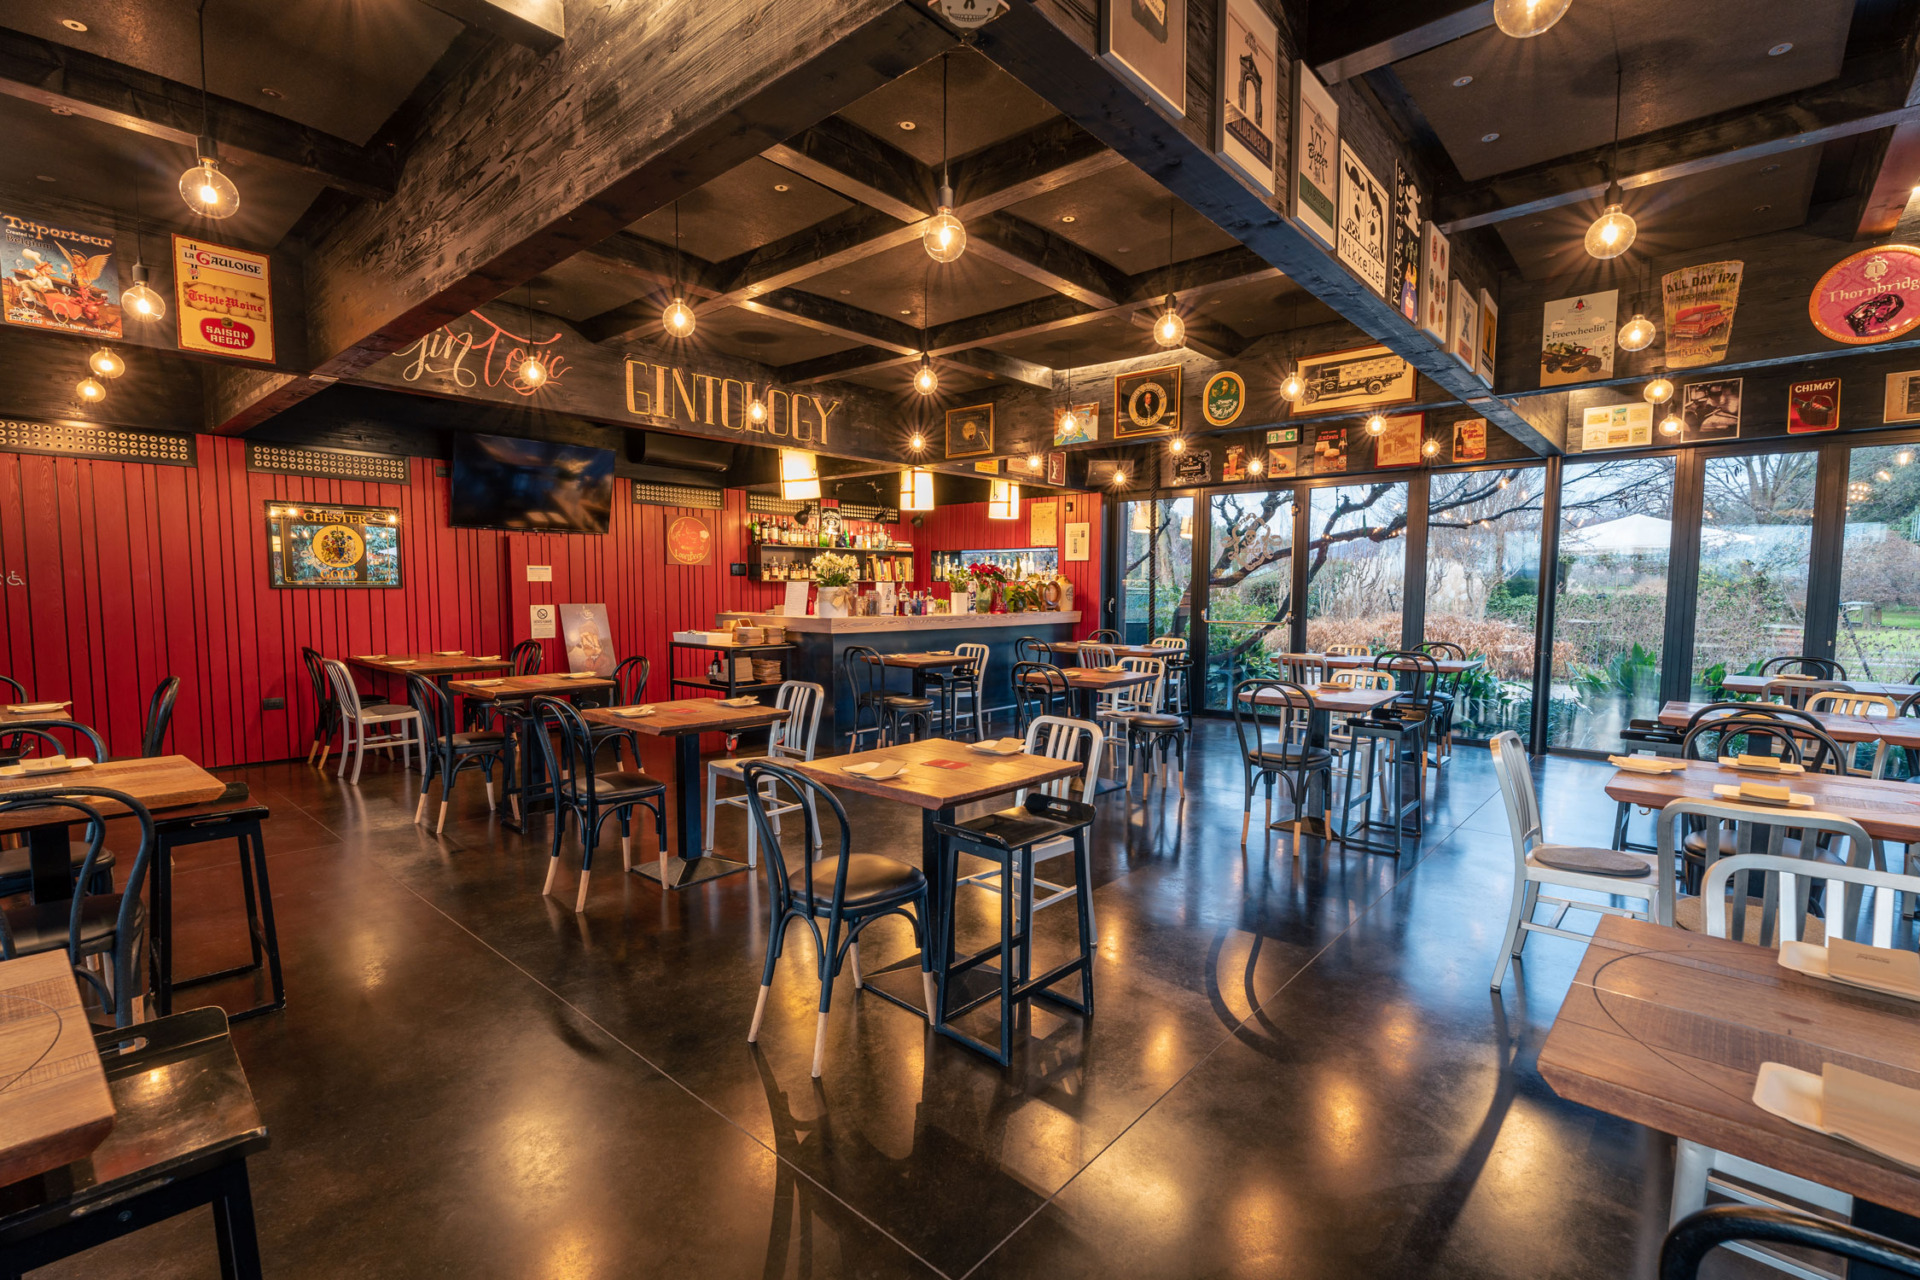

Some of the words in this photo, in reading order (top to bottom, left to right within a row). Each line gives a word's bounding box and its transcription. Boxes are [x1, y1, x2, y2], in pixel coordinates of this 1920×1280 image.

[2, 215, 113, 249] Triporteur
[5, 228, 27, 237] Created
[5, 234, 53, 250] Belgium
[184, 251, 195, 260] LA
[196, 251, 262, 276] GAULOISE
[1340, 233, 1385, 287] Mikkeller
[1666, 279, 1688, 295] ALL
[1692, 274, 1715, 287] DAY
[1717, 272, 1738, 283] IPA
[1829, 276, 1920, 302] Thornbridg
[187, 288, 225, 306] Triple
[225, 295, 264, 313] Moine
[206, 325, 249, 340] SAISON
[1552, 322, 1608, 339] Freewheelin'
[210, 333, 247, 348] REGAL
[1794, 380, 1837, 394] CHIMAY
[625, 358, 840, 446] GINTOLOGY
[303, 512, 367, 524] CHESTER
[320, 570, 358, 580] GOLD
